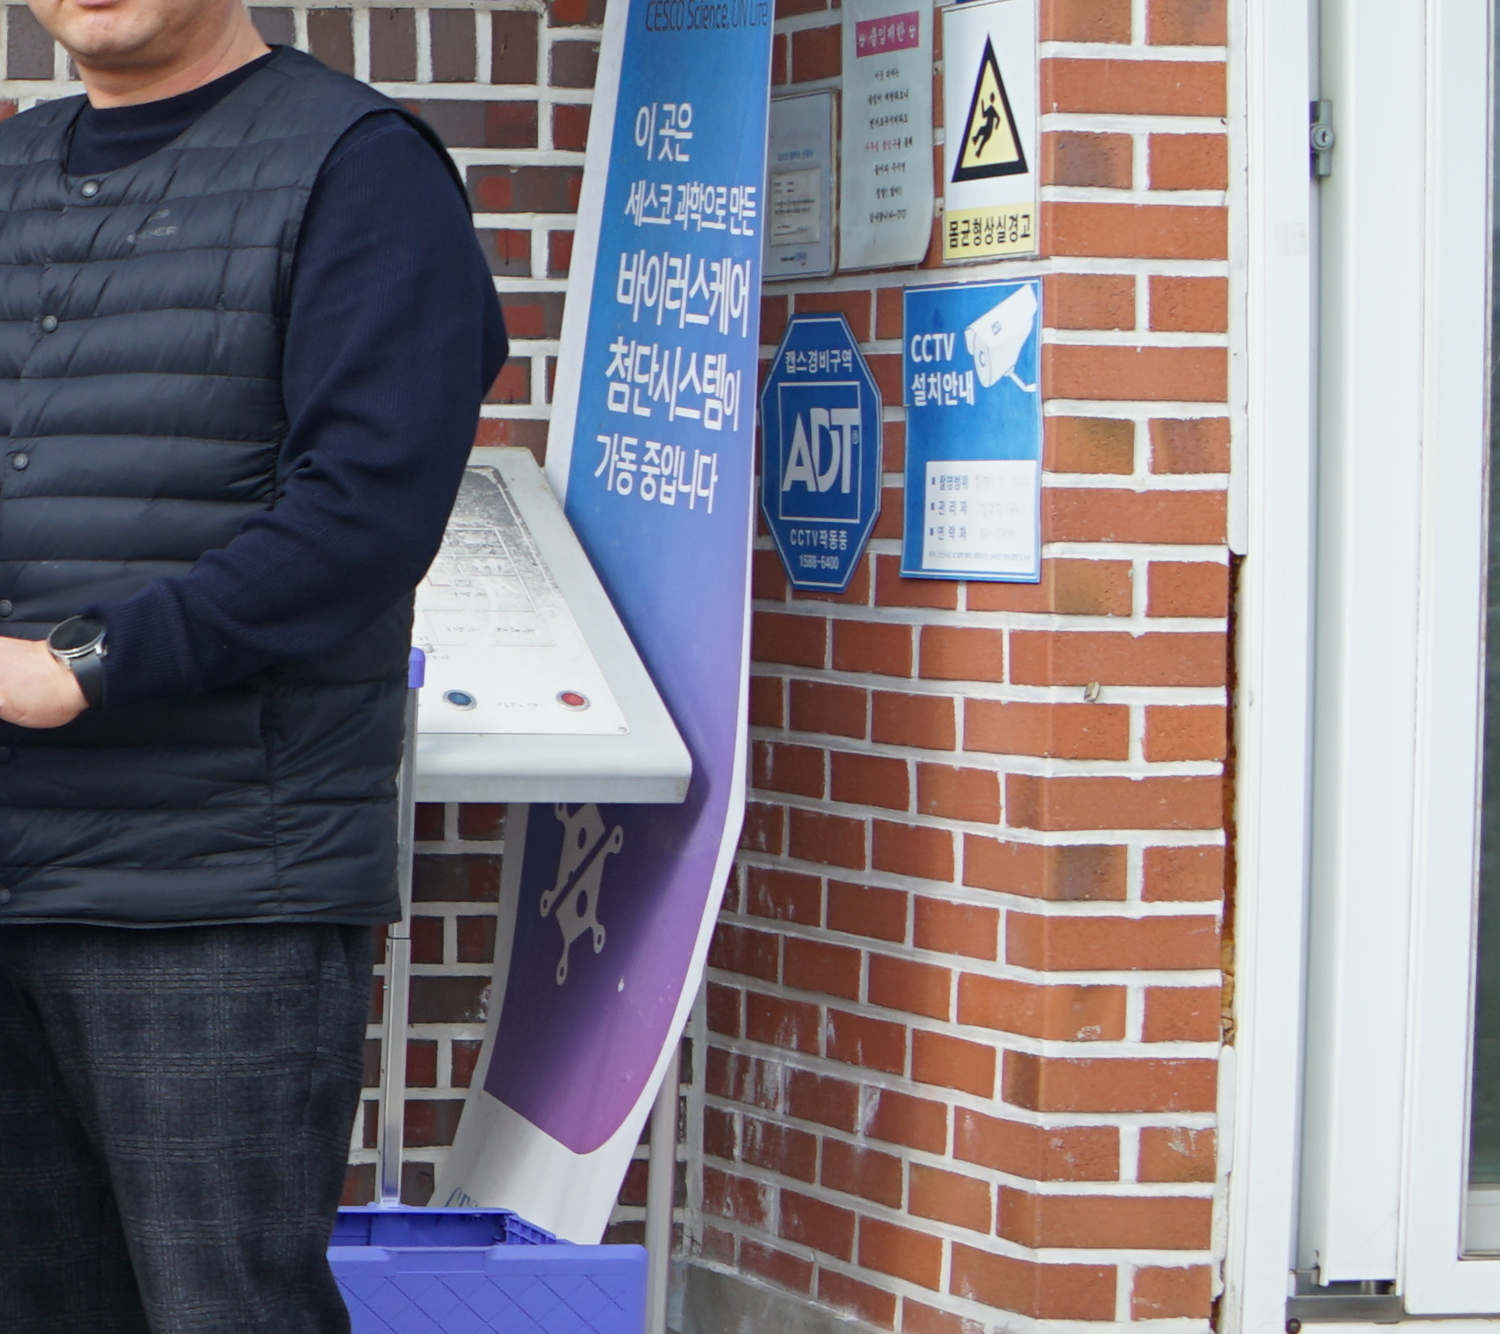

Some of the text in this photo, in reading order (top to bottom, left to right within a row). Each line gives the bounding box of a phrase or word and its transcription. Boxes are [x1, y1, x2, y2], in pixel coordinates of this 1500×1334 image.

[634, 102, 694, 162] 이 곳은
[624, 178, 672, 227] 세스코
[674, 180, 727, 232] 과학으로
[729, 184, 757, 236] 만든
[947, 213, 1031, 249] 몸균형상실경고
[616, 249, 751, 339] 바이러스케어
[785, 349, 853, 374] 캡스경비구역
[911, 332, 955, 364] CCTV
[605, 335, 741, 432] 첨단시스템이
[911, 369, 976, 407] 설치안내
[594, 432, 719, 515] 가동 중입니다
[781, 406, 861, 494] ADT
